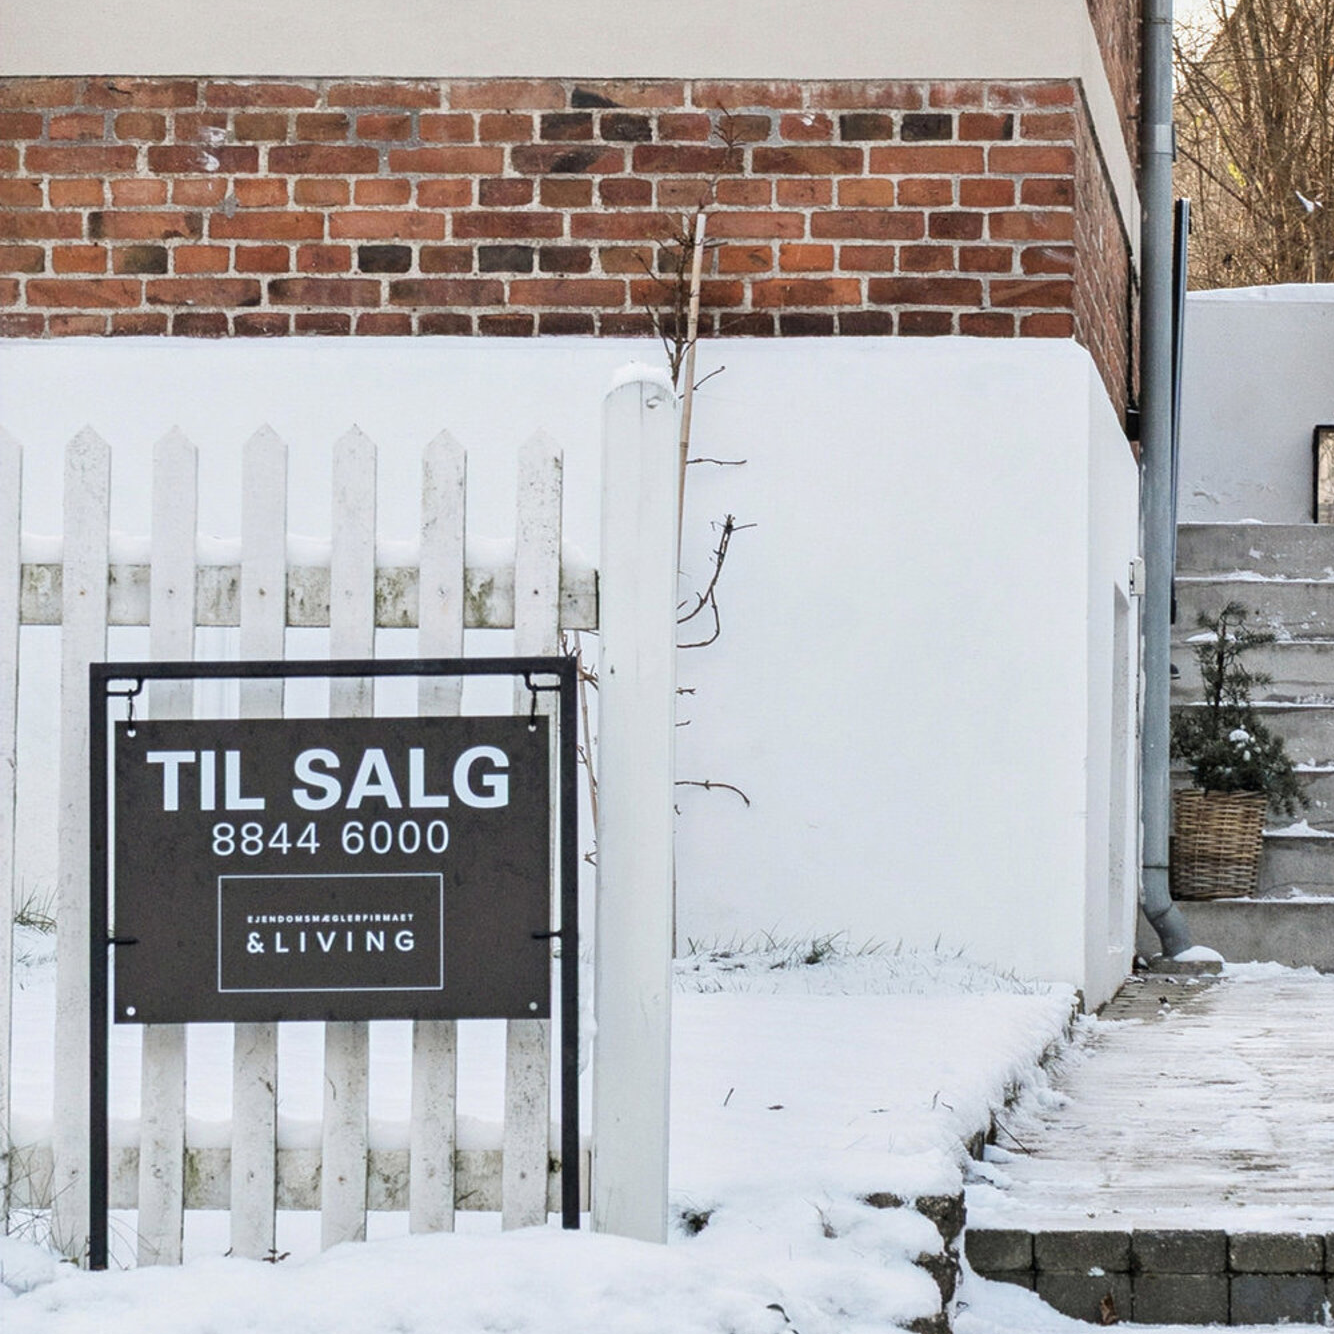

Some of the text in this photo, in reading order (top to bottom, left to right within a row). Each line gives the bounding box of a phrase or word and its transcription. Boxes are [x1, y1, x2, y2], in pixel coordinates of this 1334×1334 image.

[146, 745, 510, 812] TIL SALG
[212, 820, 450, 857] 8844 6000
[246, 913, 414, 924] EJENDOMSMÆGLERFIRMAET
